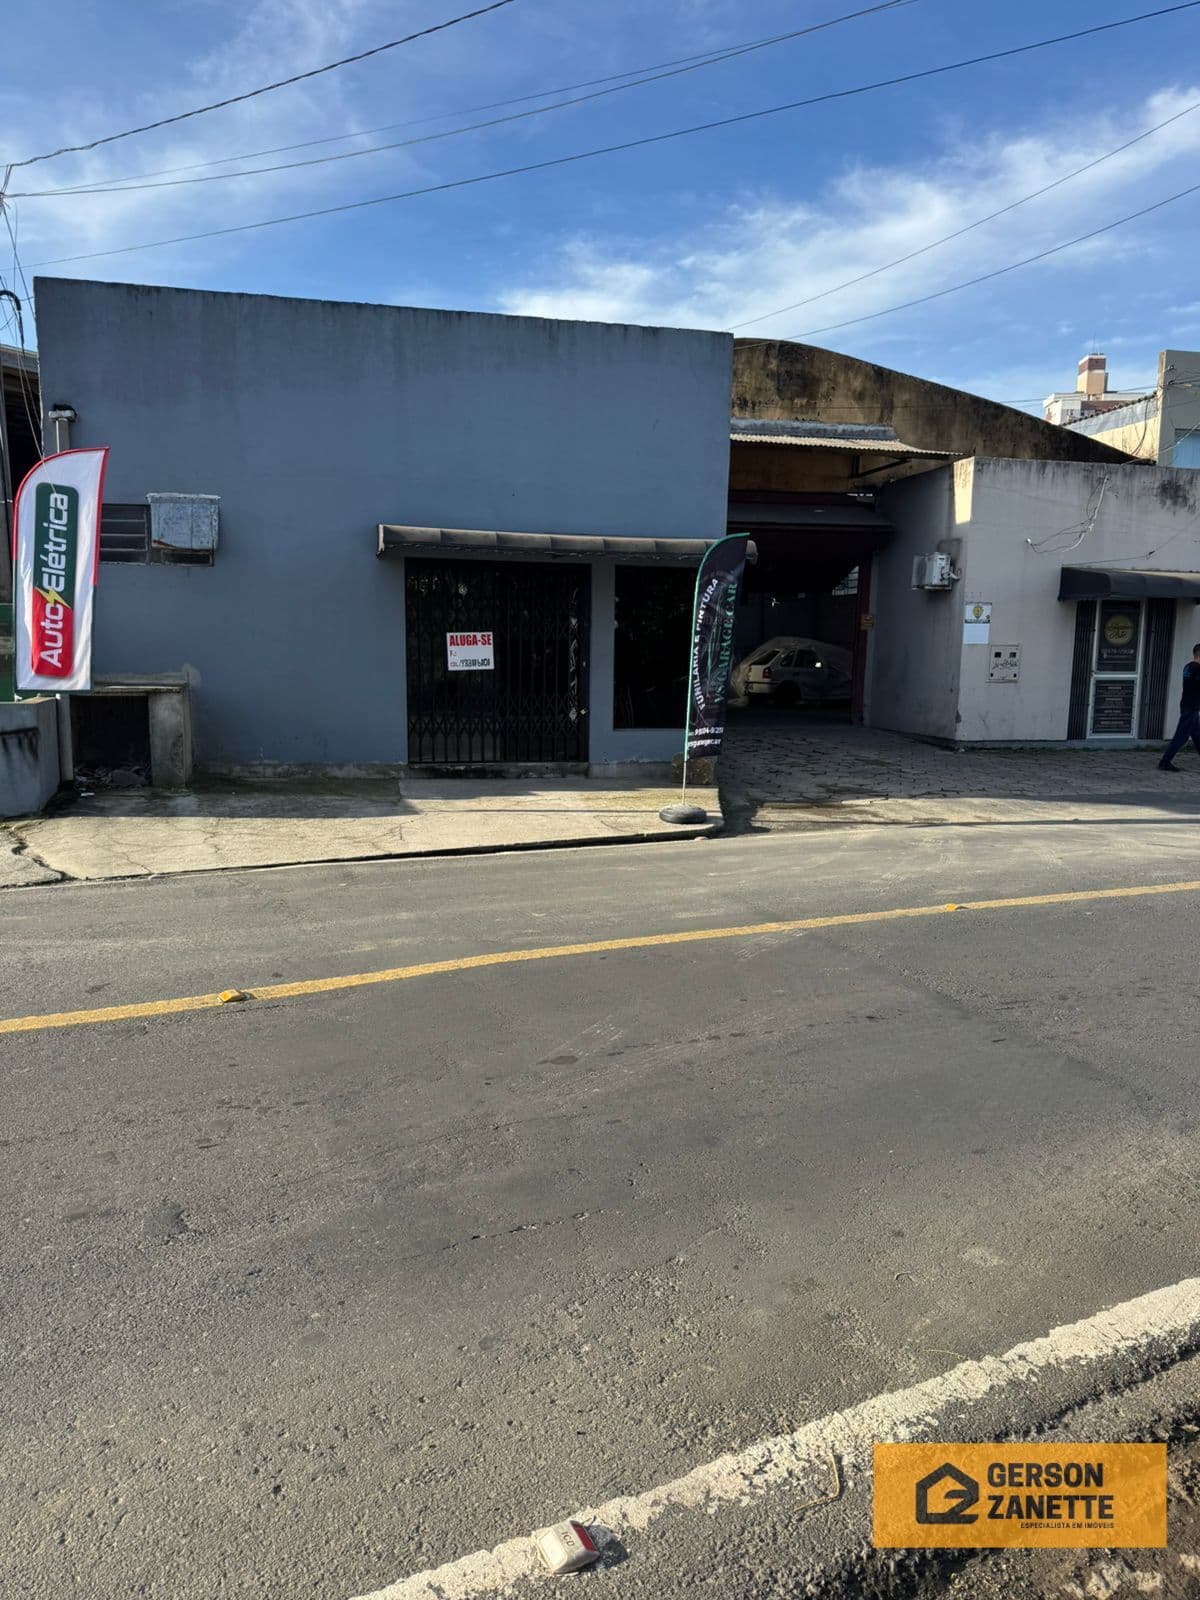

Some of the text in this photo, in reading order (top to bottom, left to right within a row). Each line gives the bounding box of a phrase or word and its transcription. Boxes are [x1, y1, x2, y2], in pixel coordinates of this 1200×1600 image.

[39, 492, 69, 668] Auto Elétrica
[449, 633, 492, 647] ALUGA-SE
